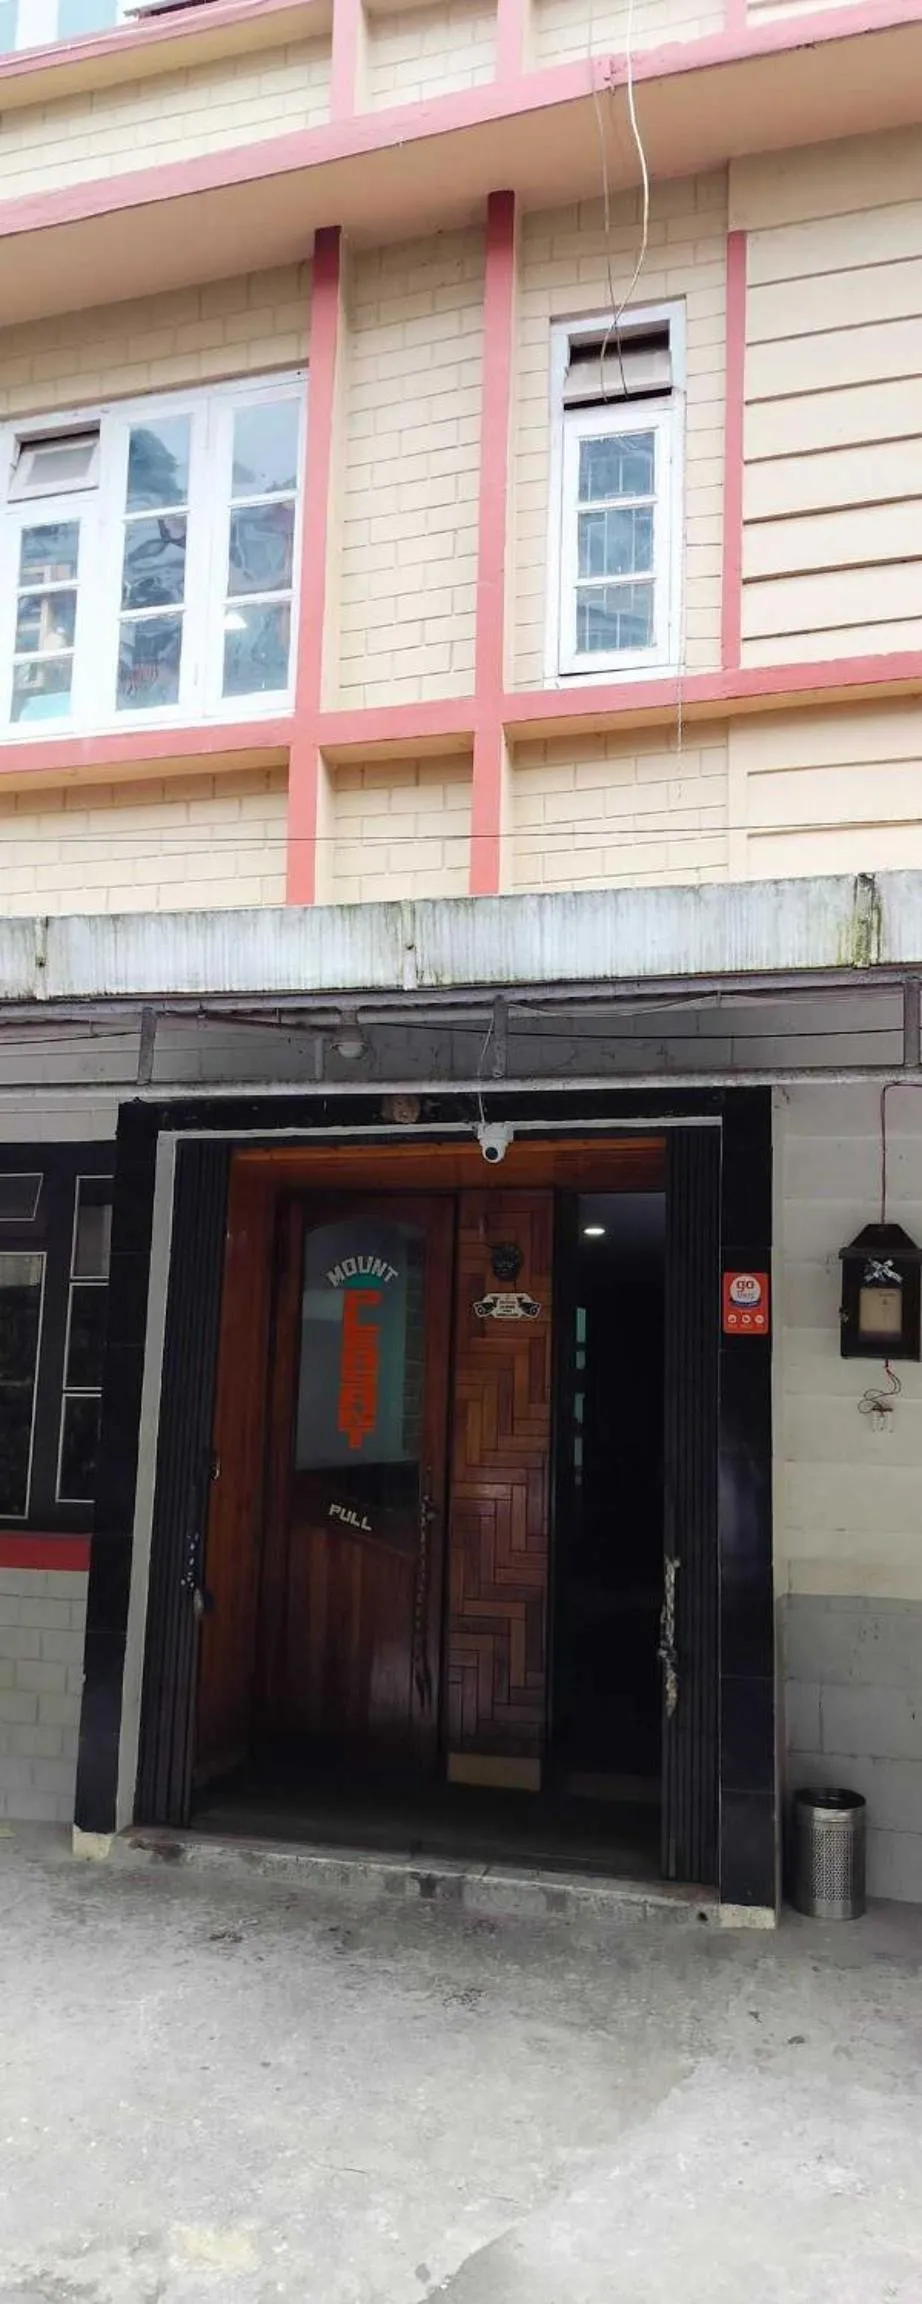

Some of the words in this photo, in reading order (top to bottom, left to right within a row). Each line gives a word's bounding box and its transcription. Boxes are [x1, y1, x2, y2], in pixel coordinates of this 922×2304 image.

[325, 1256, 399, 1287] MOUNT
[737, 1280, 754, 1292] go
[328, 1503, 373, 1532] PULL
